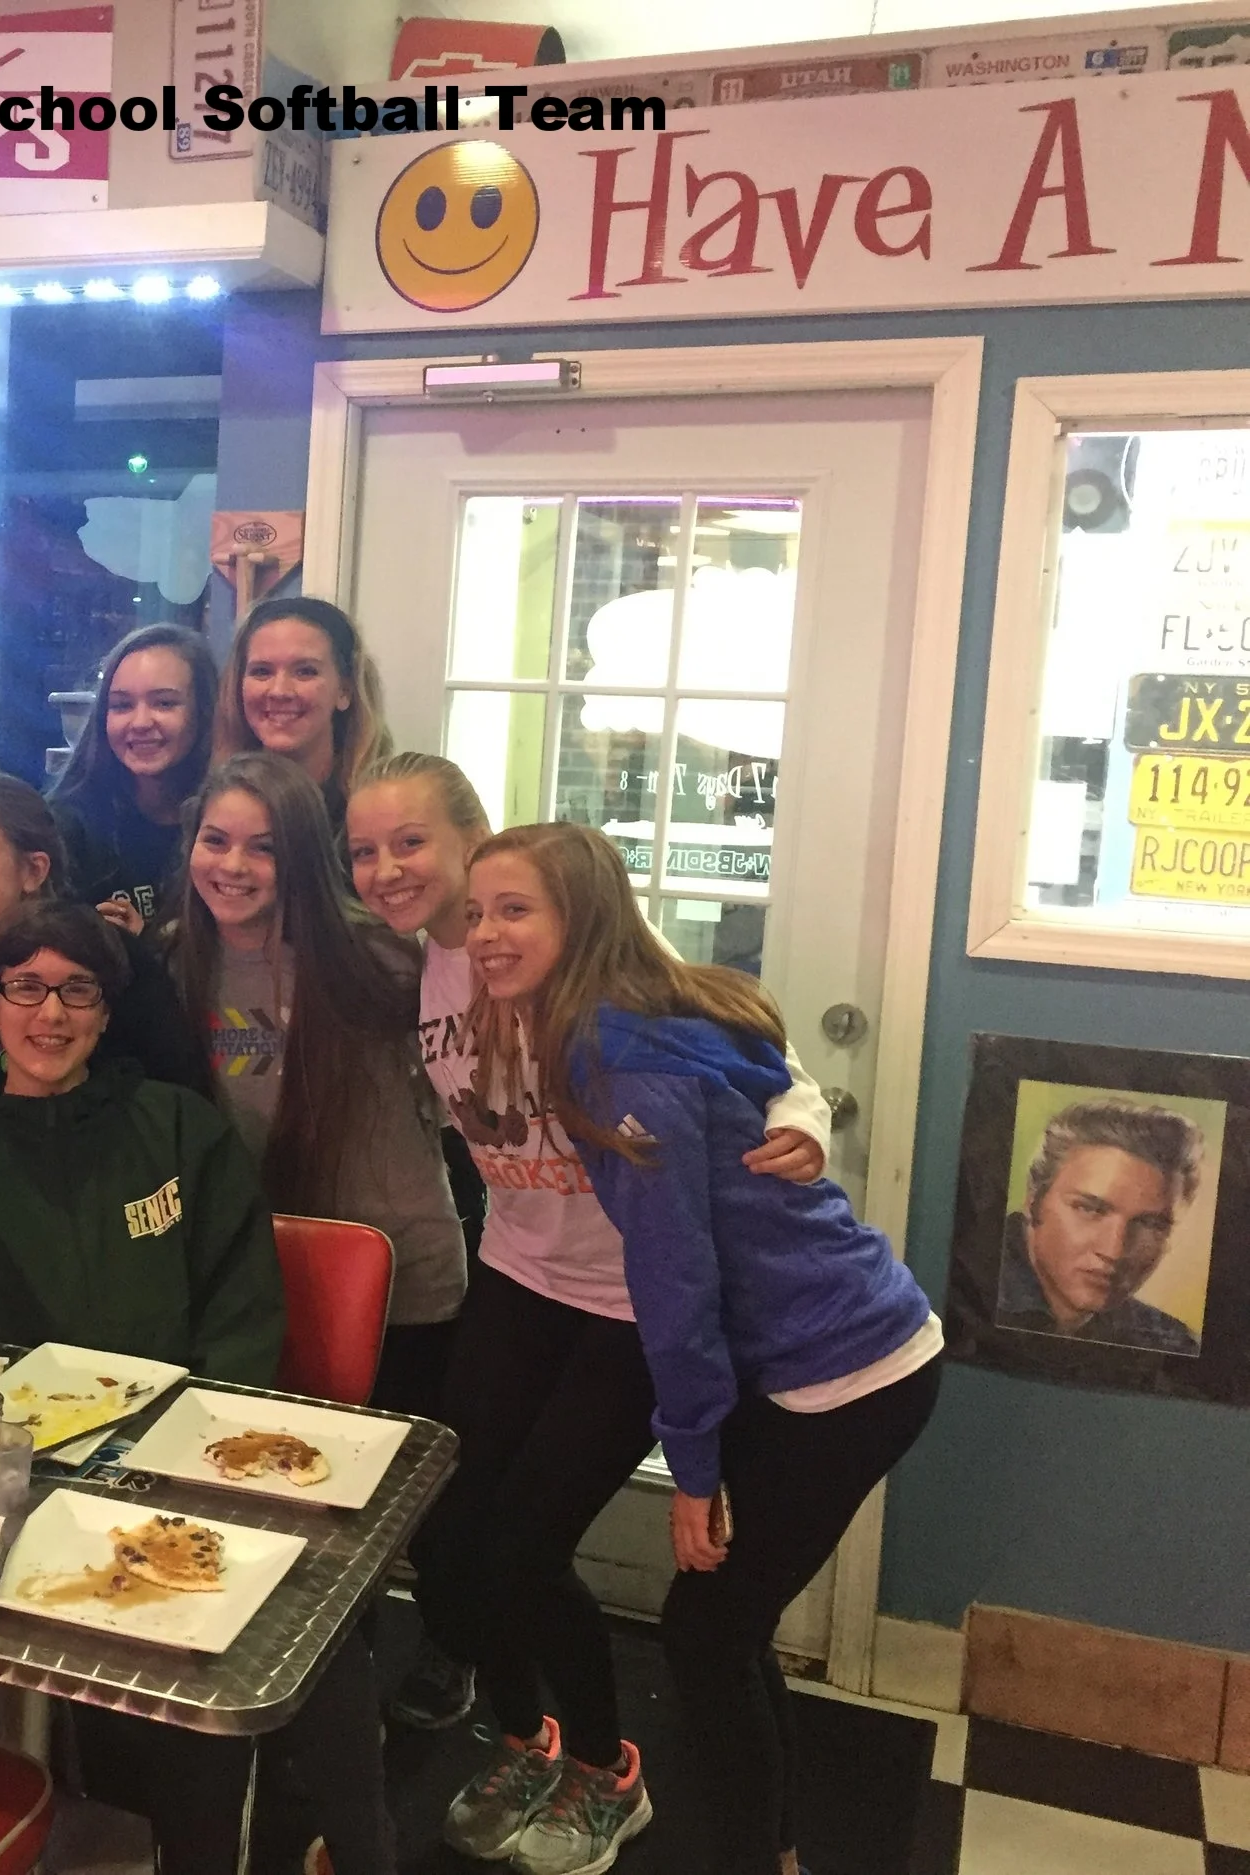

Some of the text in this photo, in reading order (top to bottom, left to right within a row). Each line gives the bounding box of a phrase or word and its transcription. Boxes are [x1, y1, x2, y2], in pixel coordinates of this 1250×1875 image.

[945, 54, 1070, 78] WASHINGTON
[780, 67, 850, 90] UTAH
[567, 129, 933, 302] Have
[965, 96, 1118, 272] A
